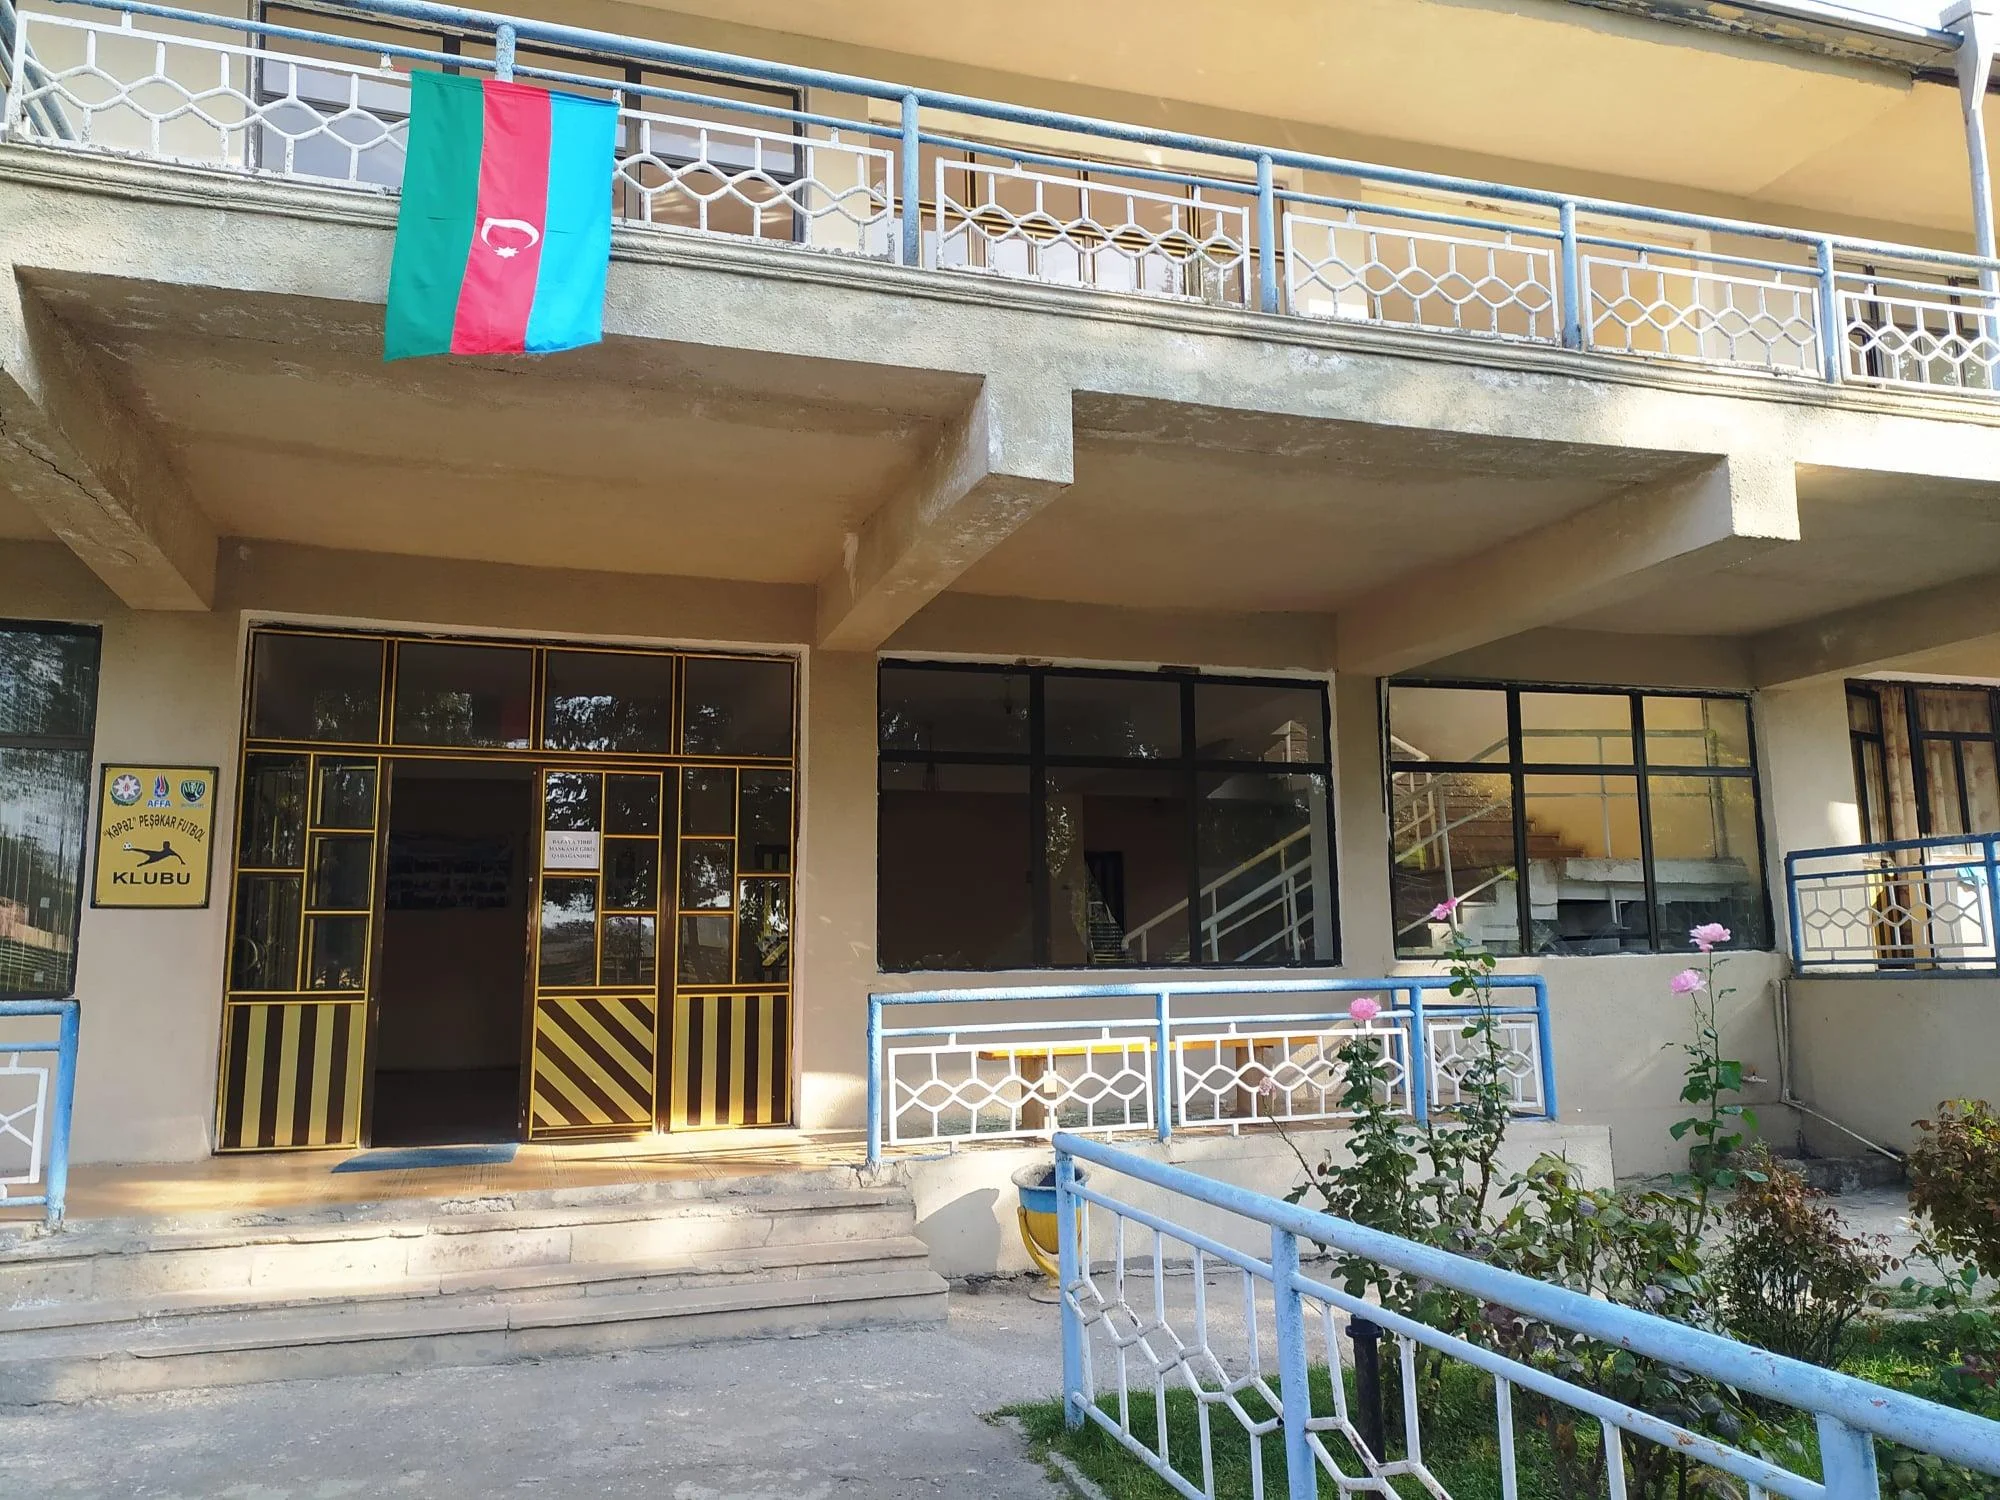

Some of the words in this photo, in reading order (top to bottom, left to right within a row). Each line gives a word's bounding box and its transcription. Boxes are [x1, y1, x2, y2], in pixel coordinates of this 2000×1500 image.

[147, 799, 171, 808] AFFA
[139, 814, 176, 829] PEŞƏKAR
[177, 818, 206, 843] FUTBOL
[112, 872, 190, 885] KLUBU
